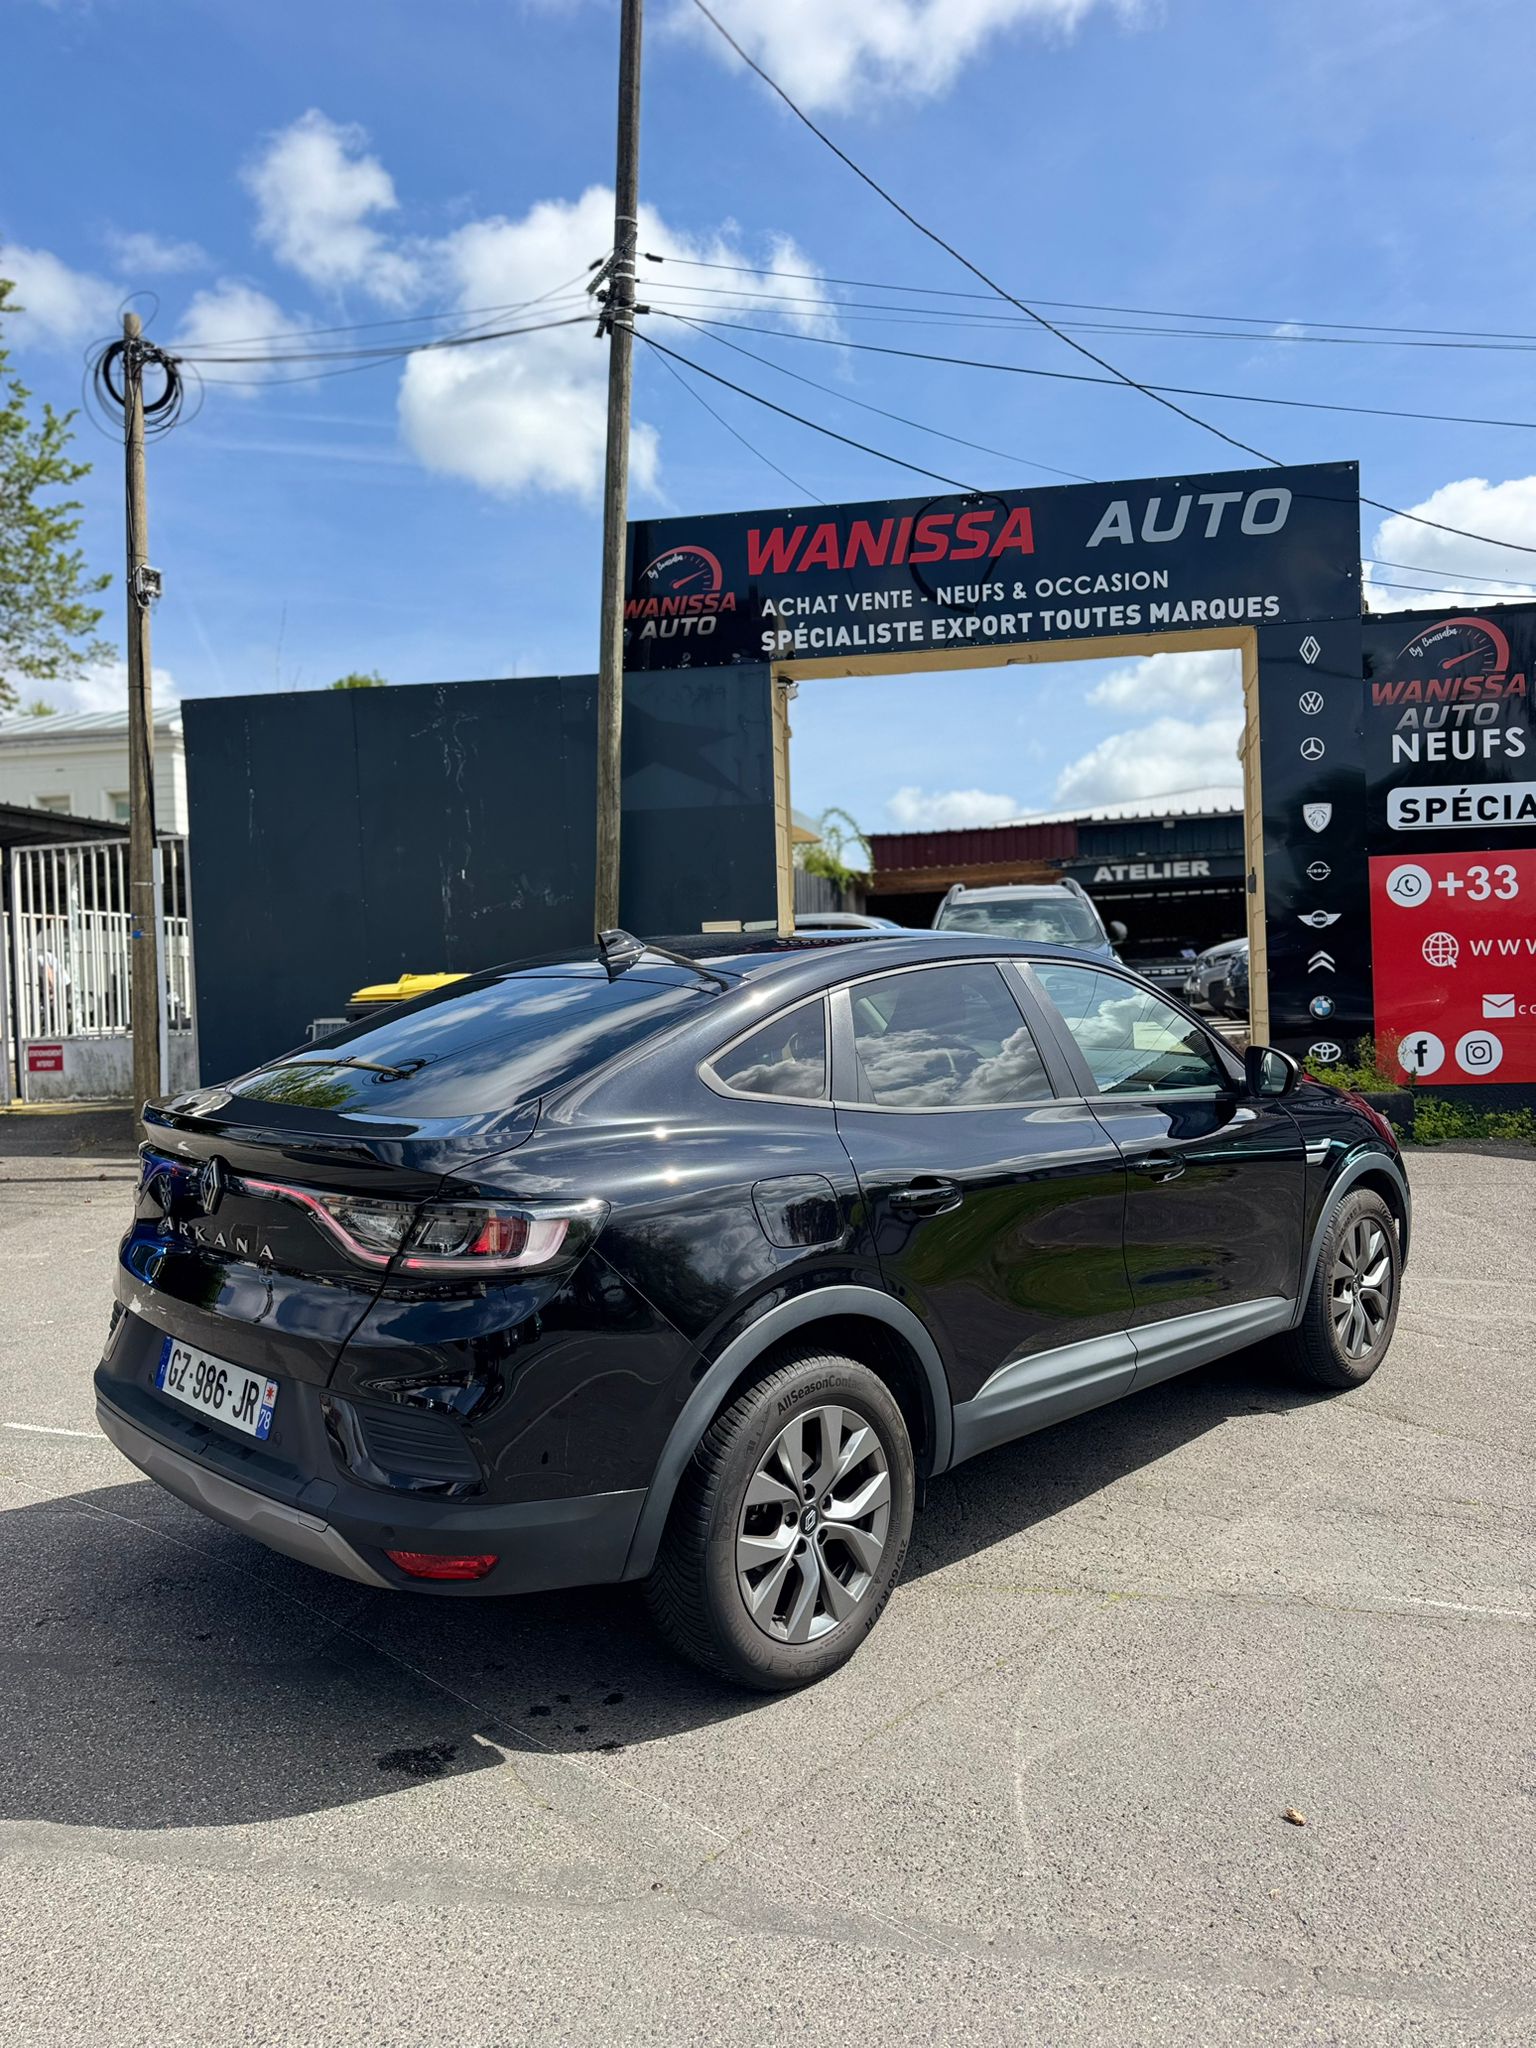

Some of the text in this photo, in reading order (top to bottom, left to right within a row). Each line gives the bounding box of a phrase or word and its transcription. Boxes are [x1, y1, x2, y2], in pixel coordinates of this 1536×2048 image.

[747, 487, 1293, 576] WANISSA AUTO
[624, 591, 737, 620] WANISSA
[761, 594, 838, 617] ACHAT
[844, 589, 913, 612] VENTE
[936, 582, 1005, 606] NEUFS
[1012, 581, 1028, 600] &
[1035, 569, 1169, 598] OCCASION
[639, 615, 718, 640] AUTO
[761, 595, 1280, 651] SPÉCIALISTE EXPORT TOUTES MARQUES
[1372, 673, 1527, 706] WANISSA
[1395, 702, 1500, 731] AUTO
[1391, 727, 1526, 764] NEUFS
[1093, 860, 1211, 882] ATELIER
[1438, 864, 1519, 901] +33
[163, 1216, 274, 1260] ARKANA
[168, 1348, 260, 1425] GZ-986-JR
[258, 1408, 272, 1430] 78
